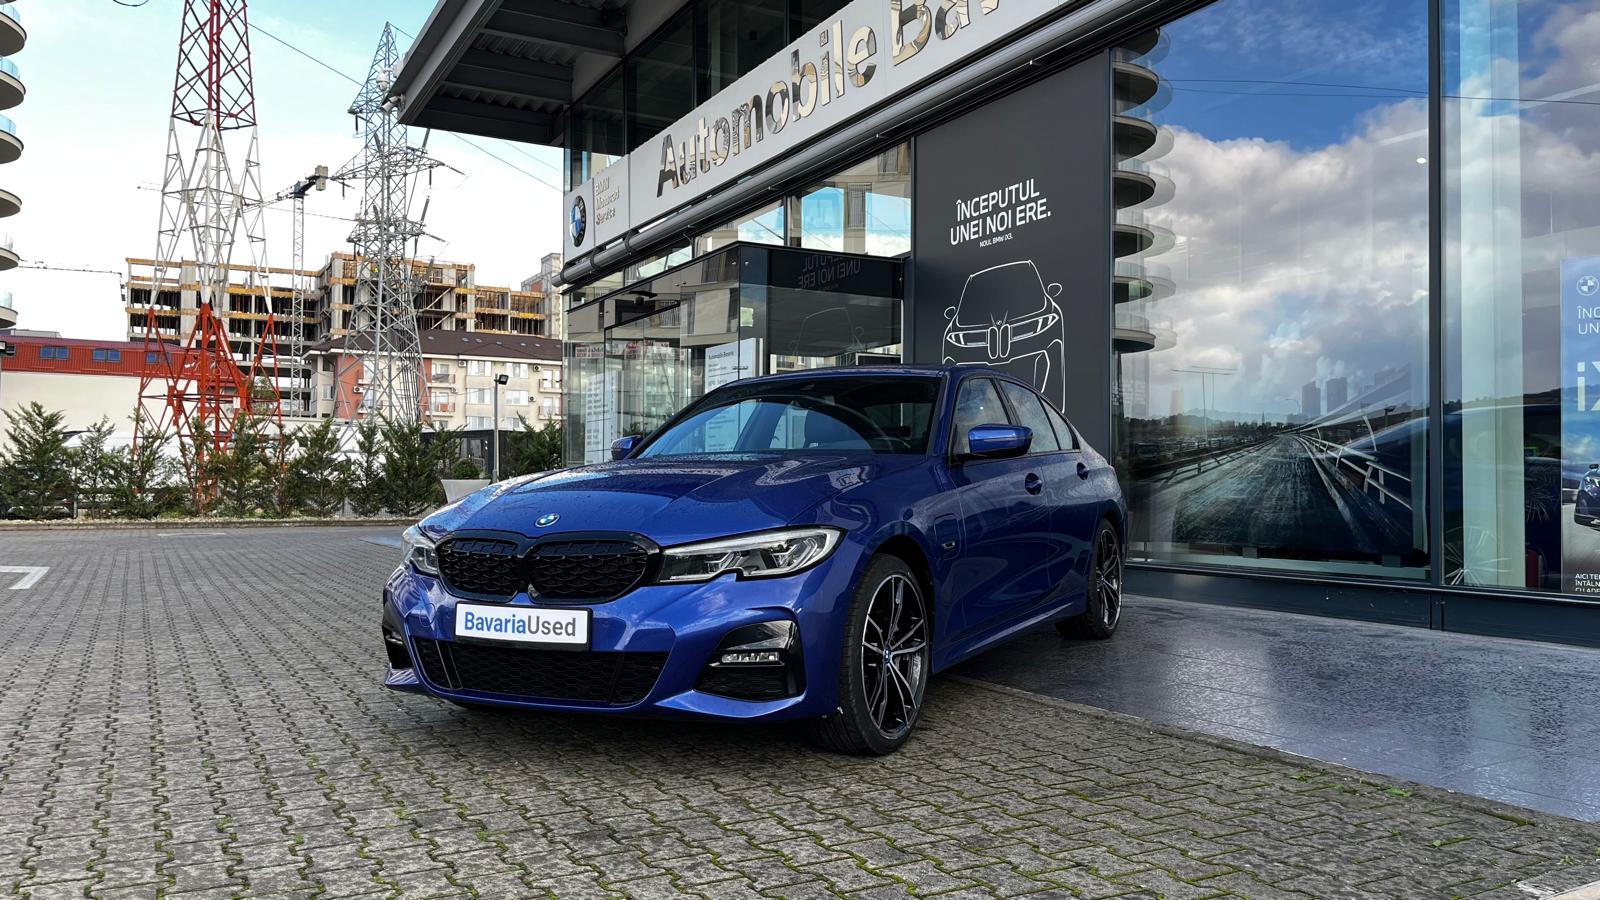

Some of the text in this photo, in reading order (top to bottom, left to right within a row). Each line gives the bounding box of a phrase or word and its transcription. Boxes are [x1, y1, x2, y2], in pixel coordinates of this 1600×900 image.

[656, 0, 999, 198] Automobile Ba
[950, 198, 1051, 245] UNEI NOI ERE.
[956, 178, 1040, 222] ÎNCEPUTUL
[464, 611, 576, 637] BavariaUsed
